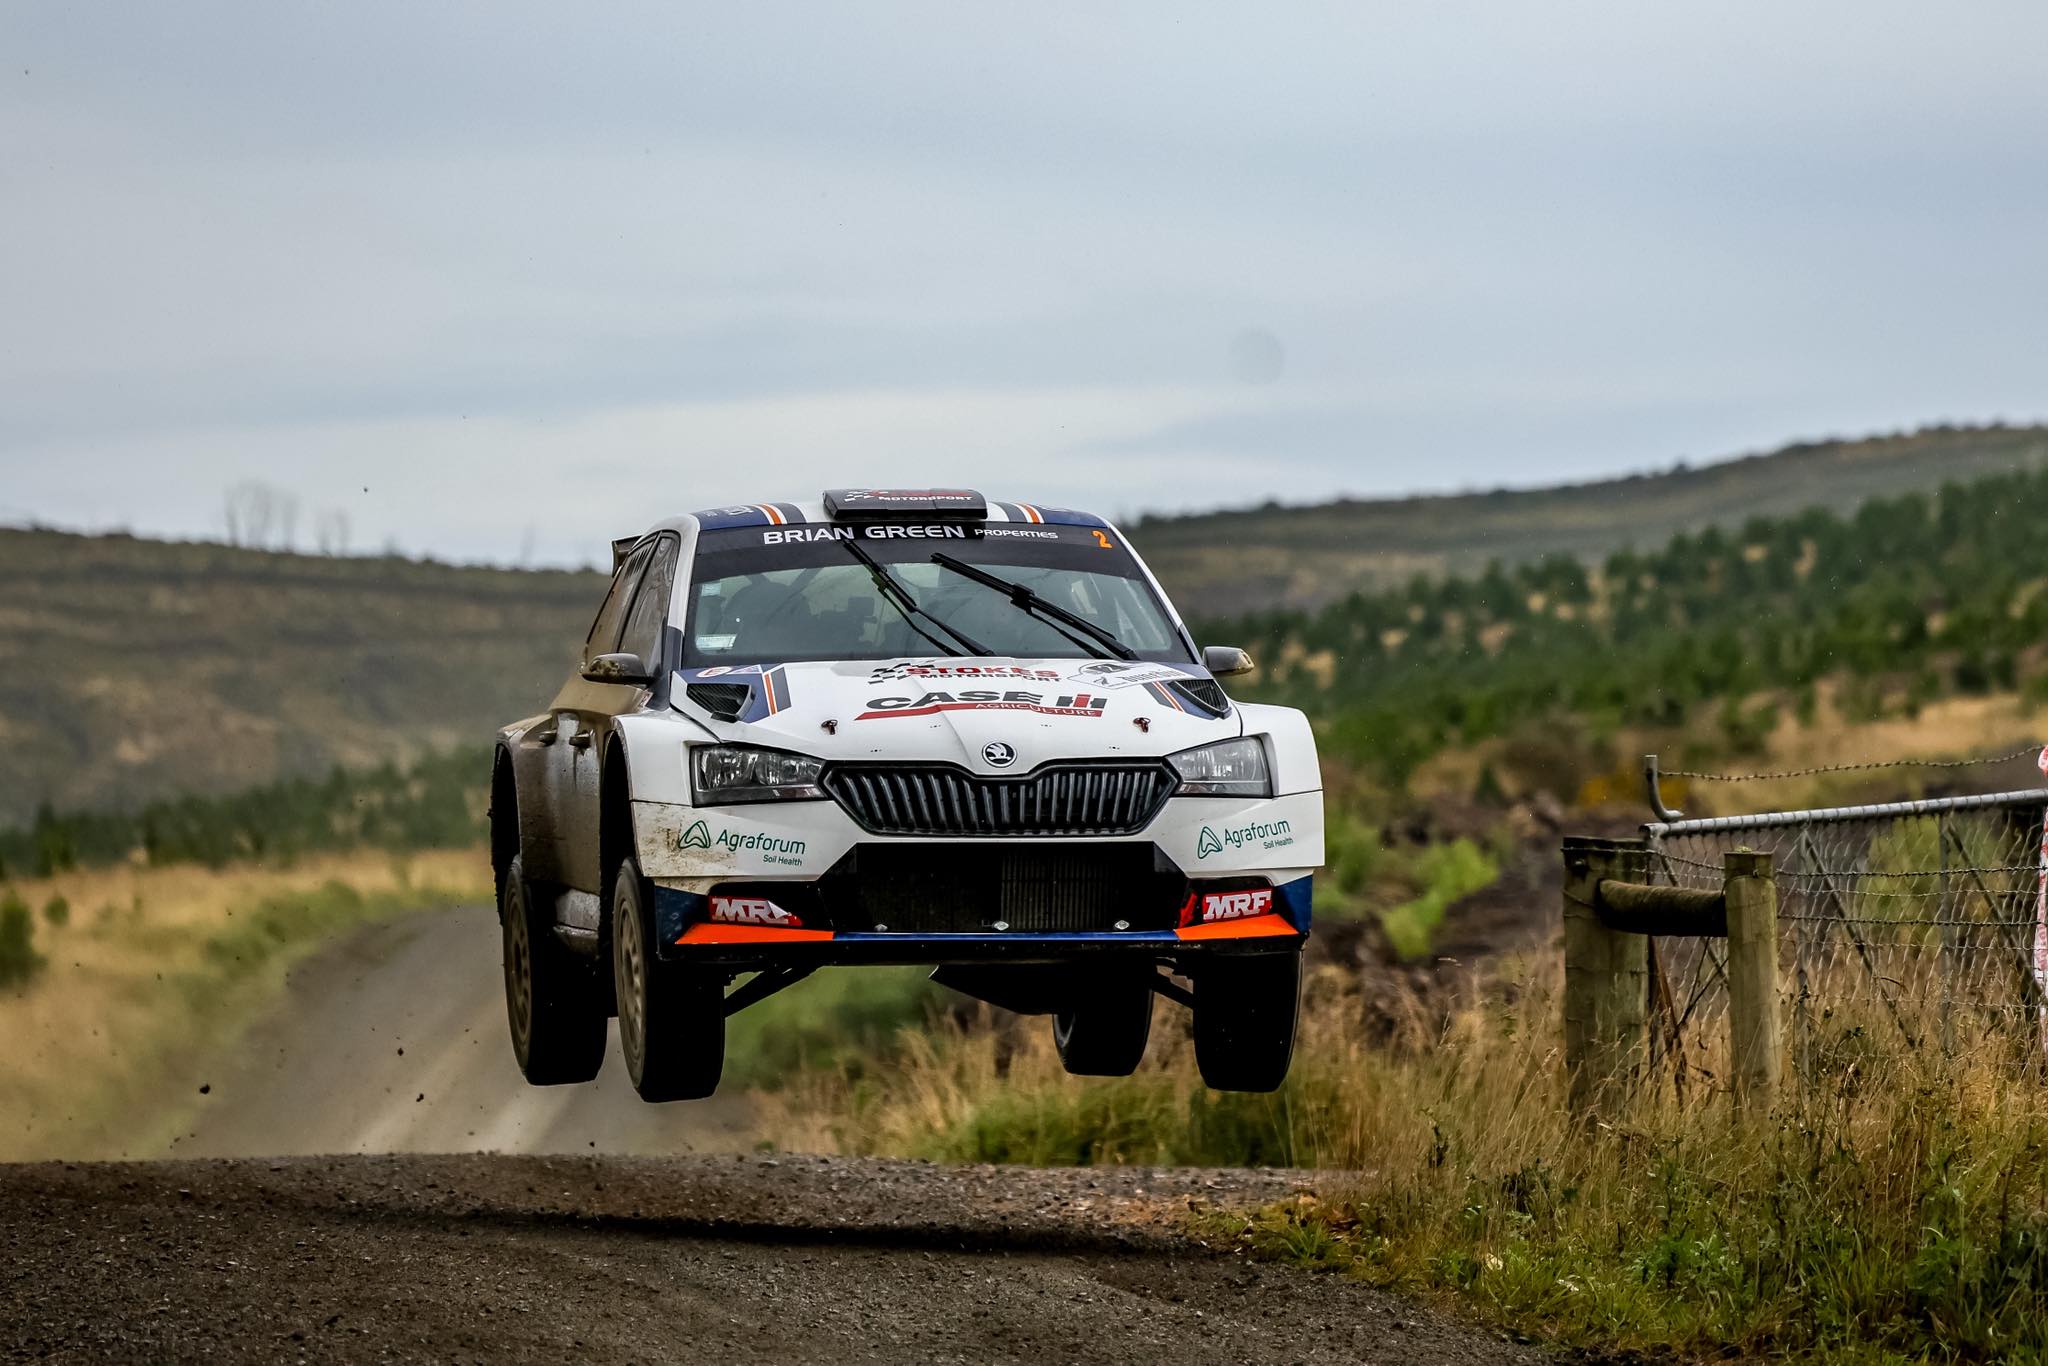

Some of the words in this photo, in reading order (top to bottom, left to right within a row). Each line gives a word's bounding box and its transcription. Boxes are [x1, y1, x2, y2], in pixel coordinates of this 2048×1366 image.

[763, 526, 855, 545] BRIAN
[865, 525, 966, 539] GREEN
[974, 529, 1059, 539] PROPERTIES
[1092, 530, 1113, 549] 2
[906, 667, 1059, 678] STOKES
[920, 674, 1062, 682] MOTORSPORT
[866, 691, 1043, 709] CASE
[975, 703, 1097, 717] AGRICULTURE
[716, 829, 806, 855] Agraforum
[1224, 820, 1291, 848] Agraforum
[1263, 840, 1274, 850] Soil
[1274, 837, 1294, 847] Health
[763, 854, 777, 863] Soil
[778, 855, 803, 867] Health
[1203, 890, 1272, 920] MRF
